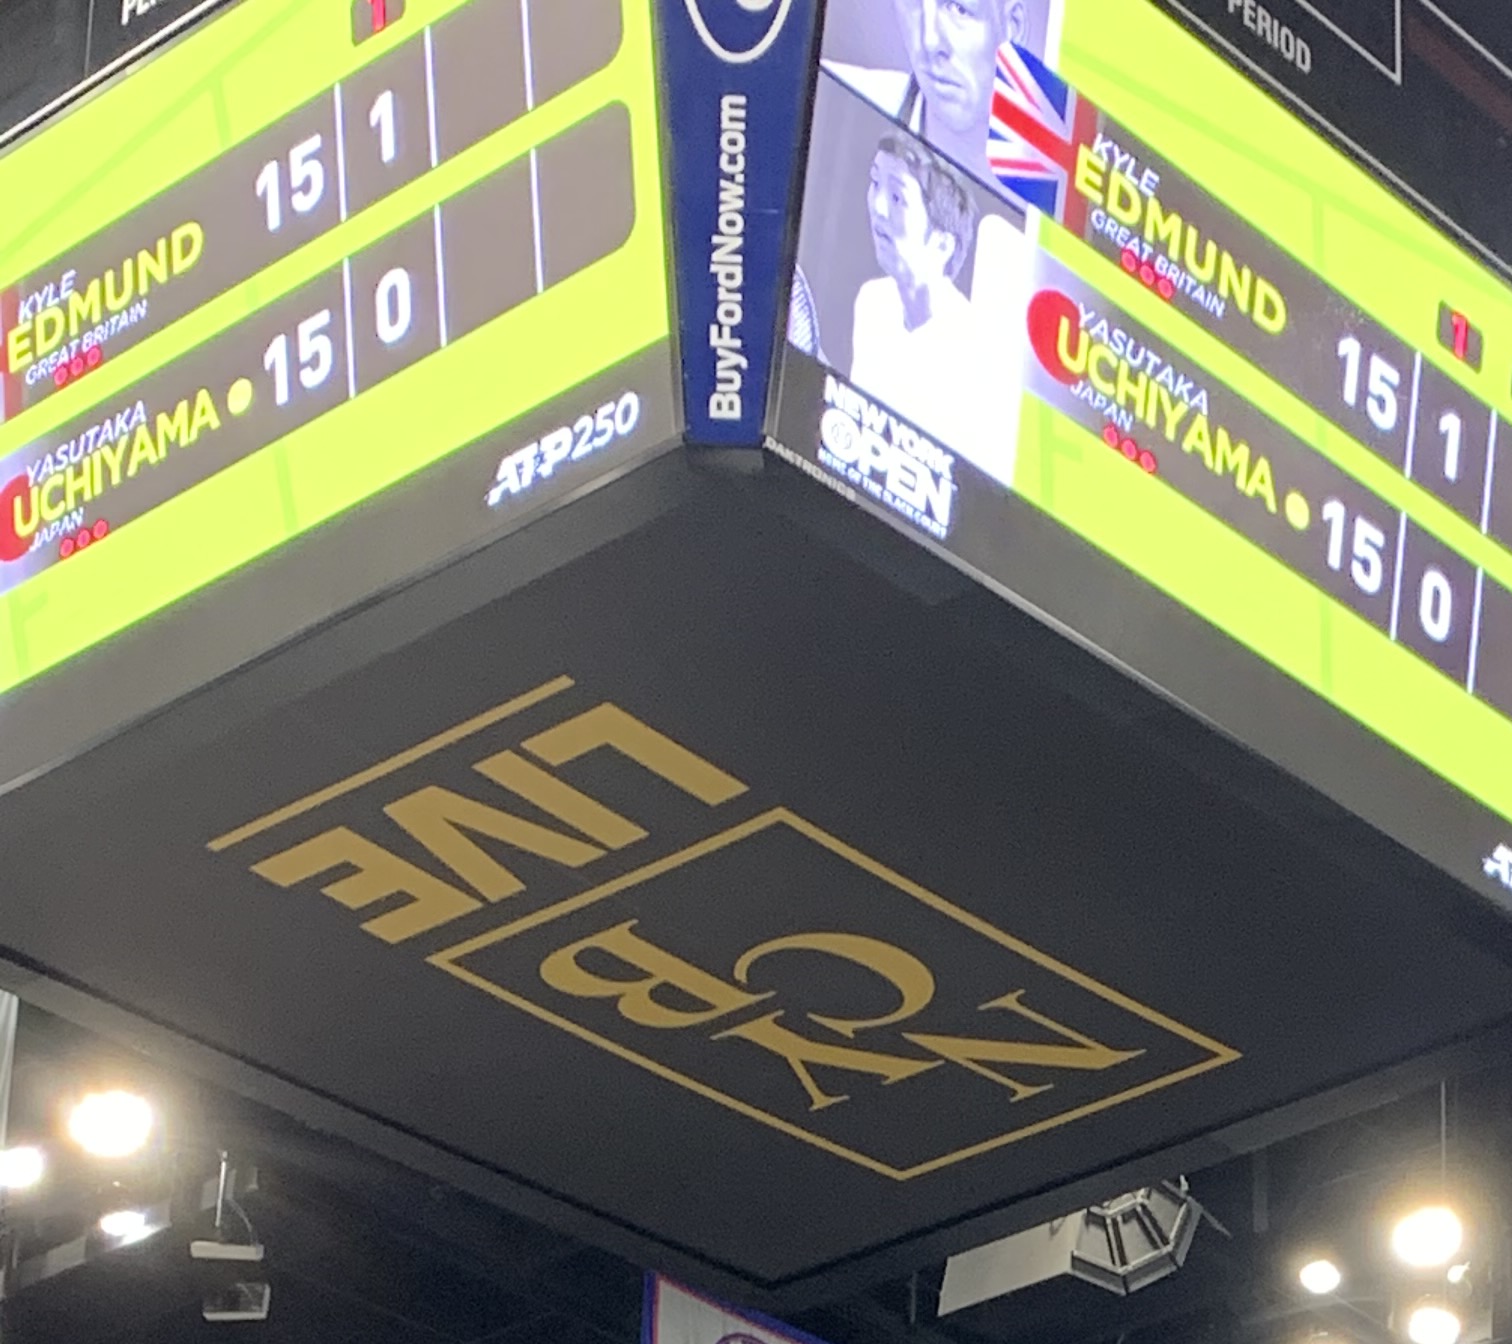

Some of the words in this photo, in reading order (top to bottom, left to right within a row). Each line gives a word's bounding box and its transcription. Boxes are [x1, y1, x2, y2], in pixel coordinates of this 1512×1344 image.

[368, 90, 397, 163] 1
[1092, 132, 1160, 198] KYLE
[255, 134, 325, 232] 15
[708, 93, 749, 421] BuyFordNow.com
[1074, 143, 1288, 336] EDMUND
[1090, 208, 1154, 264] GREAT
[1154, 254, 1227, 320] BRITAIN
[7, 220, 204, 375] EDMUND
[18, 269, 77, 325] KYLE
[25, 338, 81, 386] GREAT
[82, 299, 148, 352] BRITAIN
[374, 267, 412, 345] 0
[1448, 310, 1471, 361] 1
[263, 310, 333, 406] 15
[1070, 379, 1134, 433] JAPAN
[1077, 301, 1209, 417] YASUTAKA
[1337, 334, 1402, 432] 15
[26, 400, 147, 487] YASUTAKA
[824, 373, 890, 438] NEW
[885, 413, 955, 479] YORK
[1056, 315, 1279, 514] UCHIYAMA
[1438, 411, 1462, 482] 1
[13, 388, 221, 538] UCHIYAMA
[820, 408, 953, 527] OPEN
[28, 508, 84, 552] JAPAN
[1322, 498, 1386, 594] 15
[1418, 568, 1452, 643] 0
[249, 701, 750, 945] LIVE
